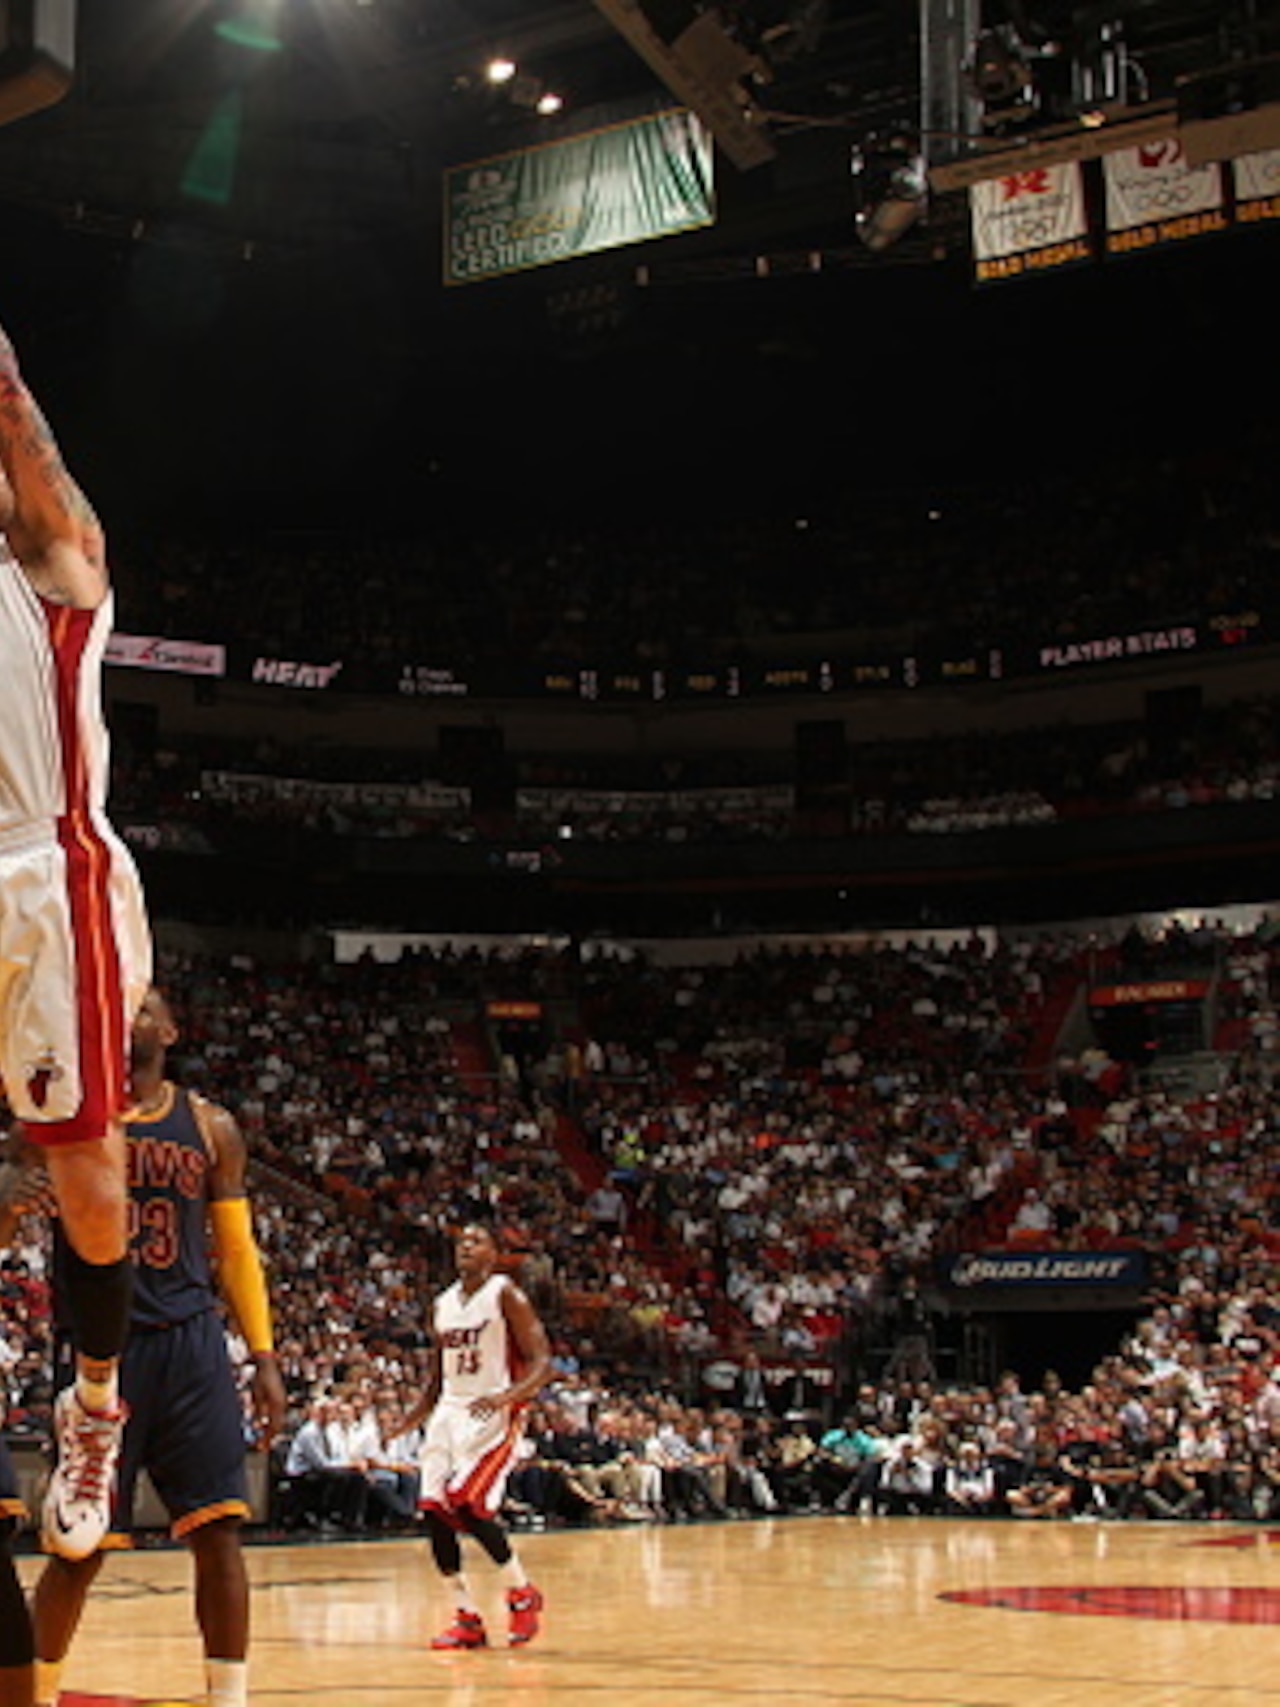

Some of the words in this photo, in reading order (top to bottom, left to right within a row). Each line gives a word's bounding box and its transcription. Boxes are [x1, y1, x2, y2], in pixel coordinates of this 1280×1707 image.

[452, 222, 506, 259] LEED
[1039, 636, 1123, 668] PLAYER
[1126, 626, 1198, 655] STATS
[251, 656, 344, 689] HEAT
[1034, 1256, 1130, 1279] LIGHT
